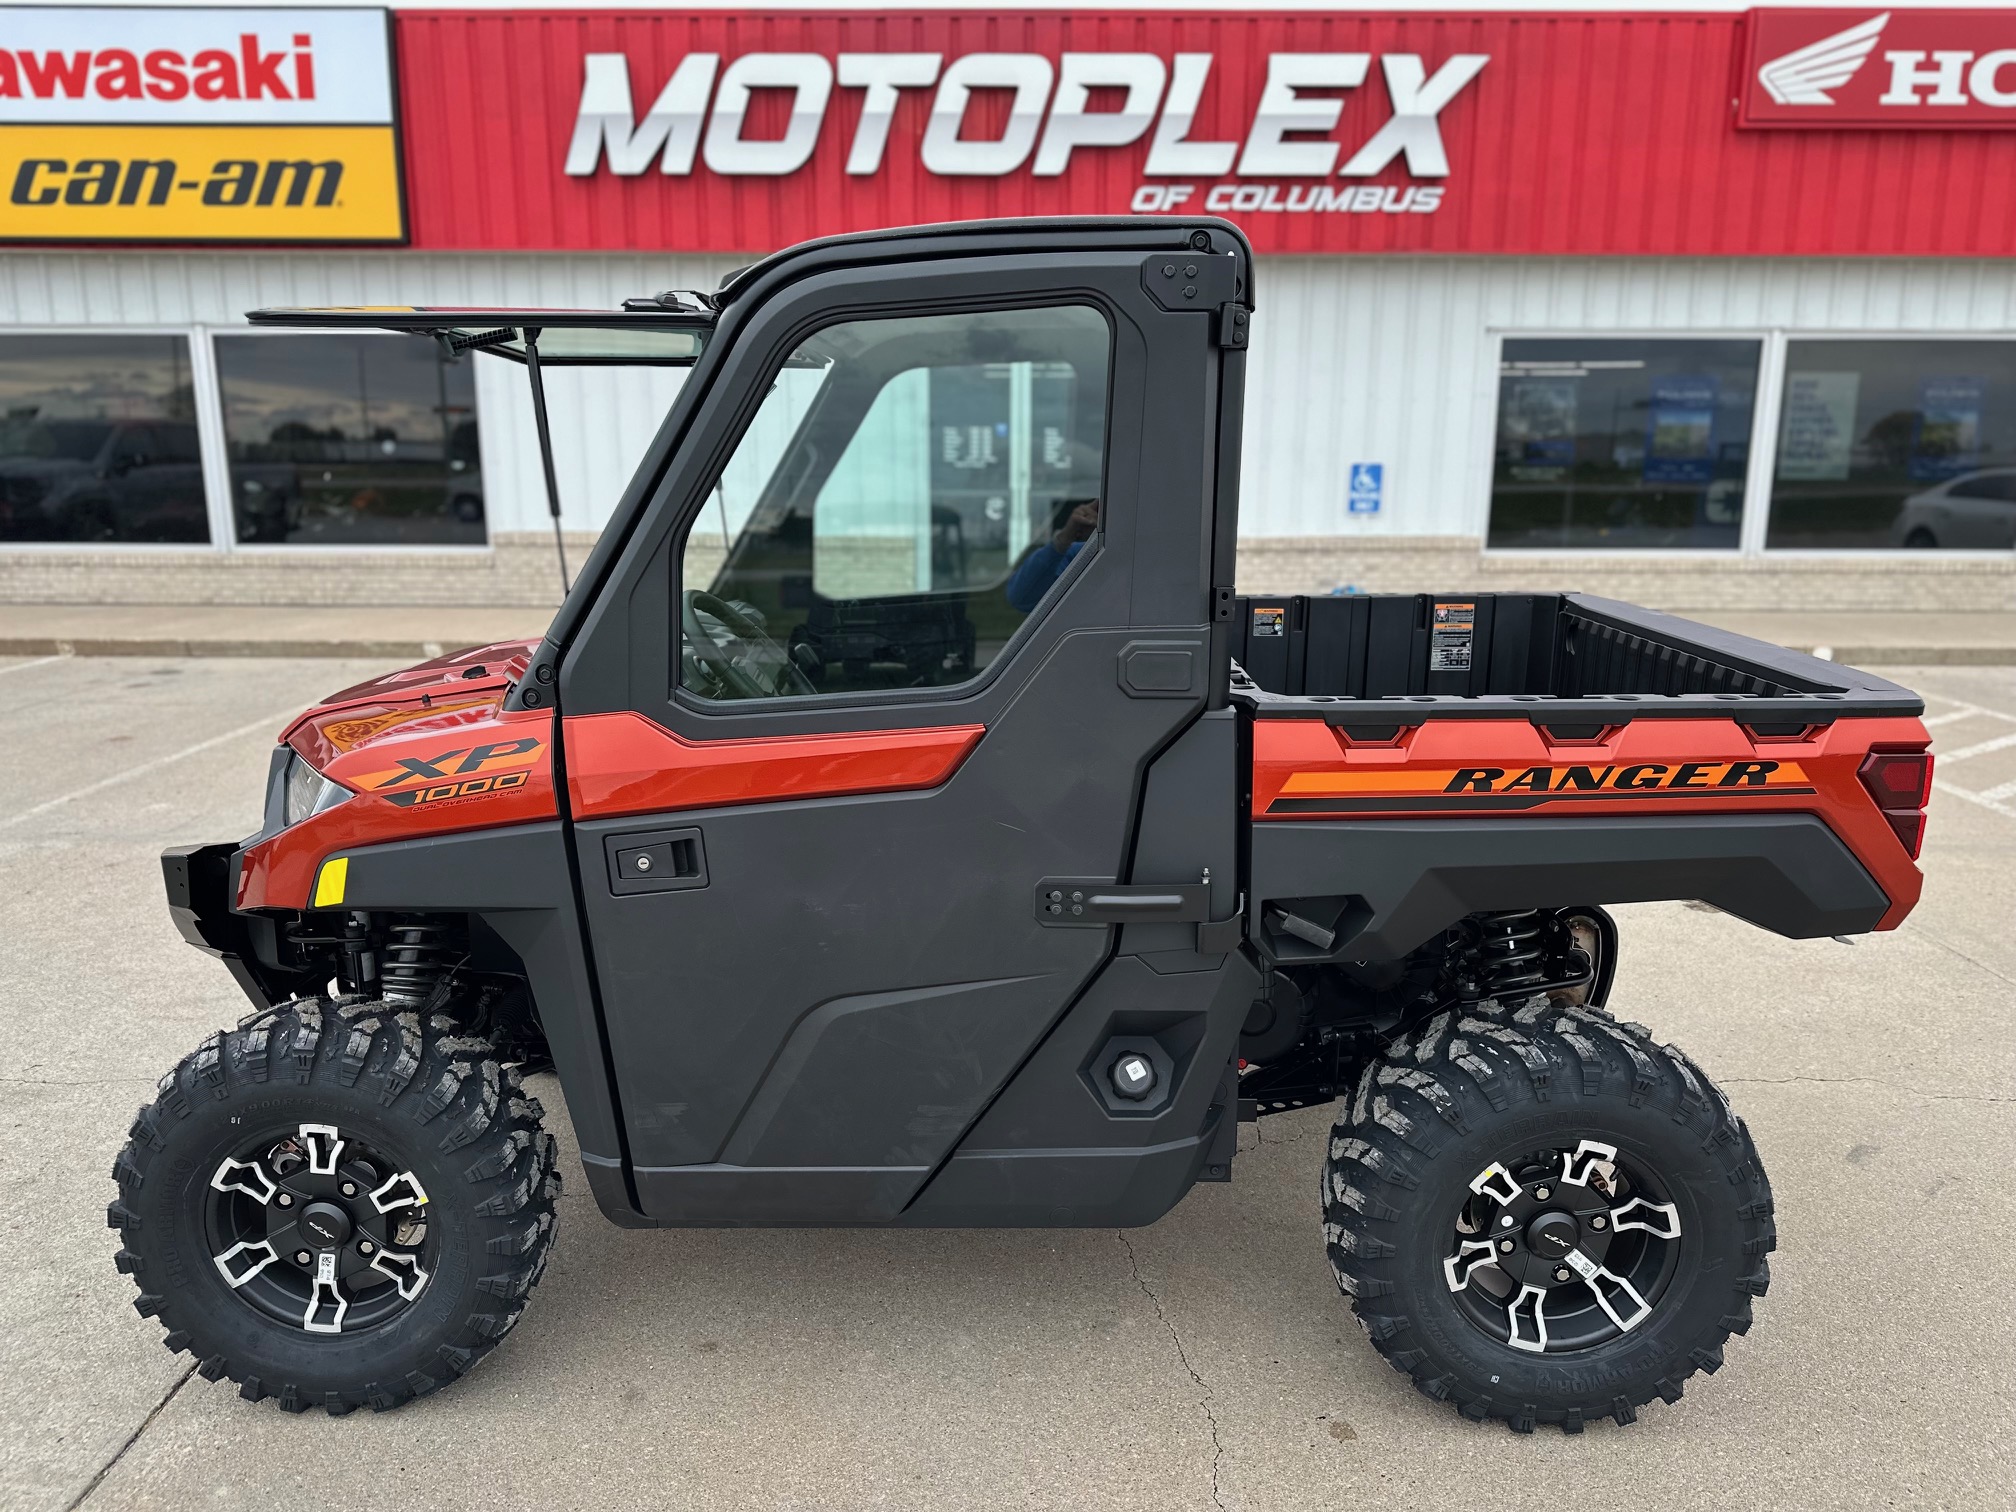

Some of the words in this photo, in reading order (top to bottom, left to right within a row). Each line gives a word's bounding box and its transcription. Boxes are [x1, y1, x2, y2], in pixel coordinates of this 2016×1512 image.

[1879, 48, 2016, 107] HO
[564, 53, 1490, 177] MOTOPLEX
[10, 158, 344, 208] can-am
[1131, 185, 1194, 212] OF
[1205, 185, 1445, 213] COLUMBUS
[374, 737, 541, 789] XP
[1442, 760, 1779, 793] RANGER
[412, 804, 440, 813] DUAL
[442, 793, 498, 808] OVERHEAD
[500, 788, 523, 797] CAM
[413, 771, 528, 804] 1000
